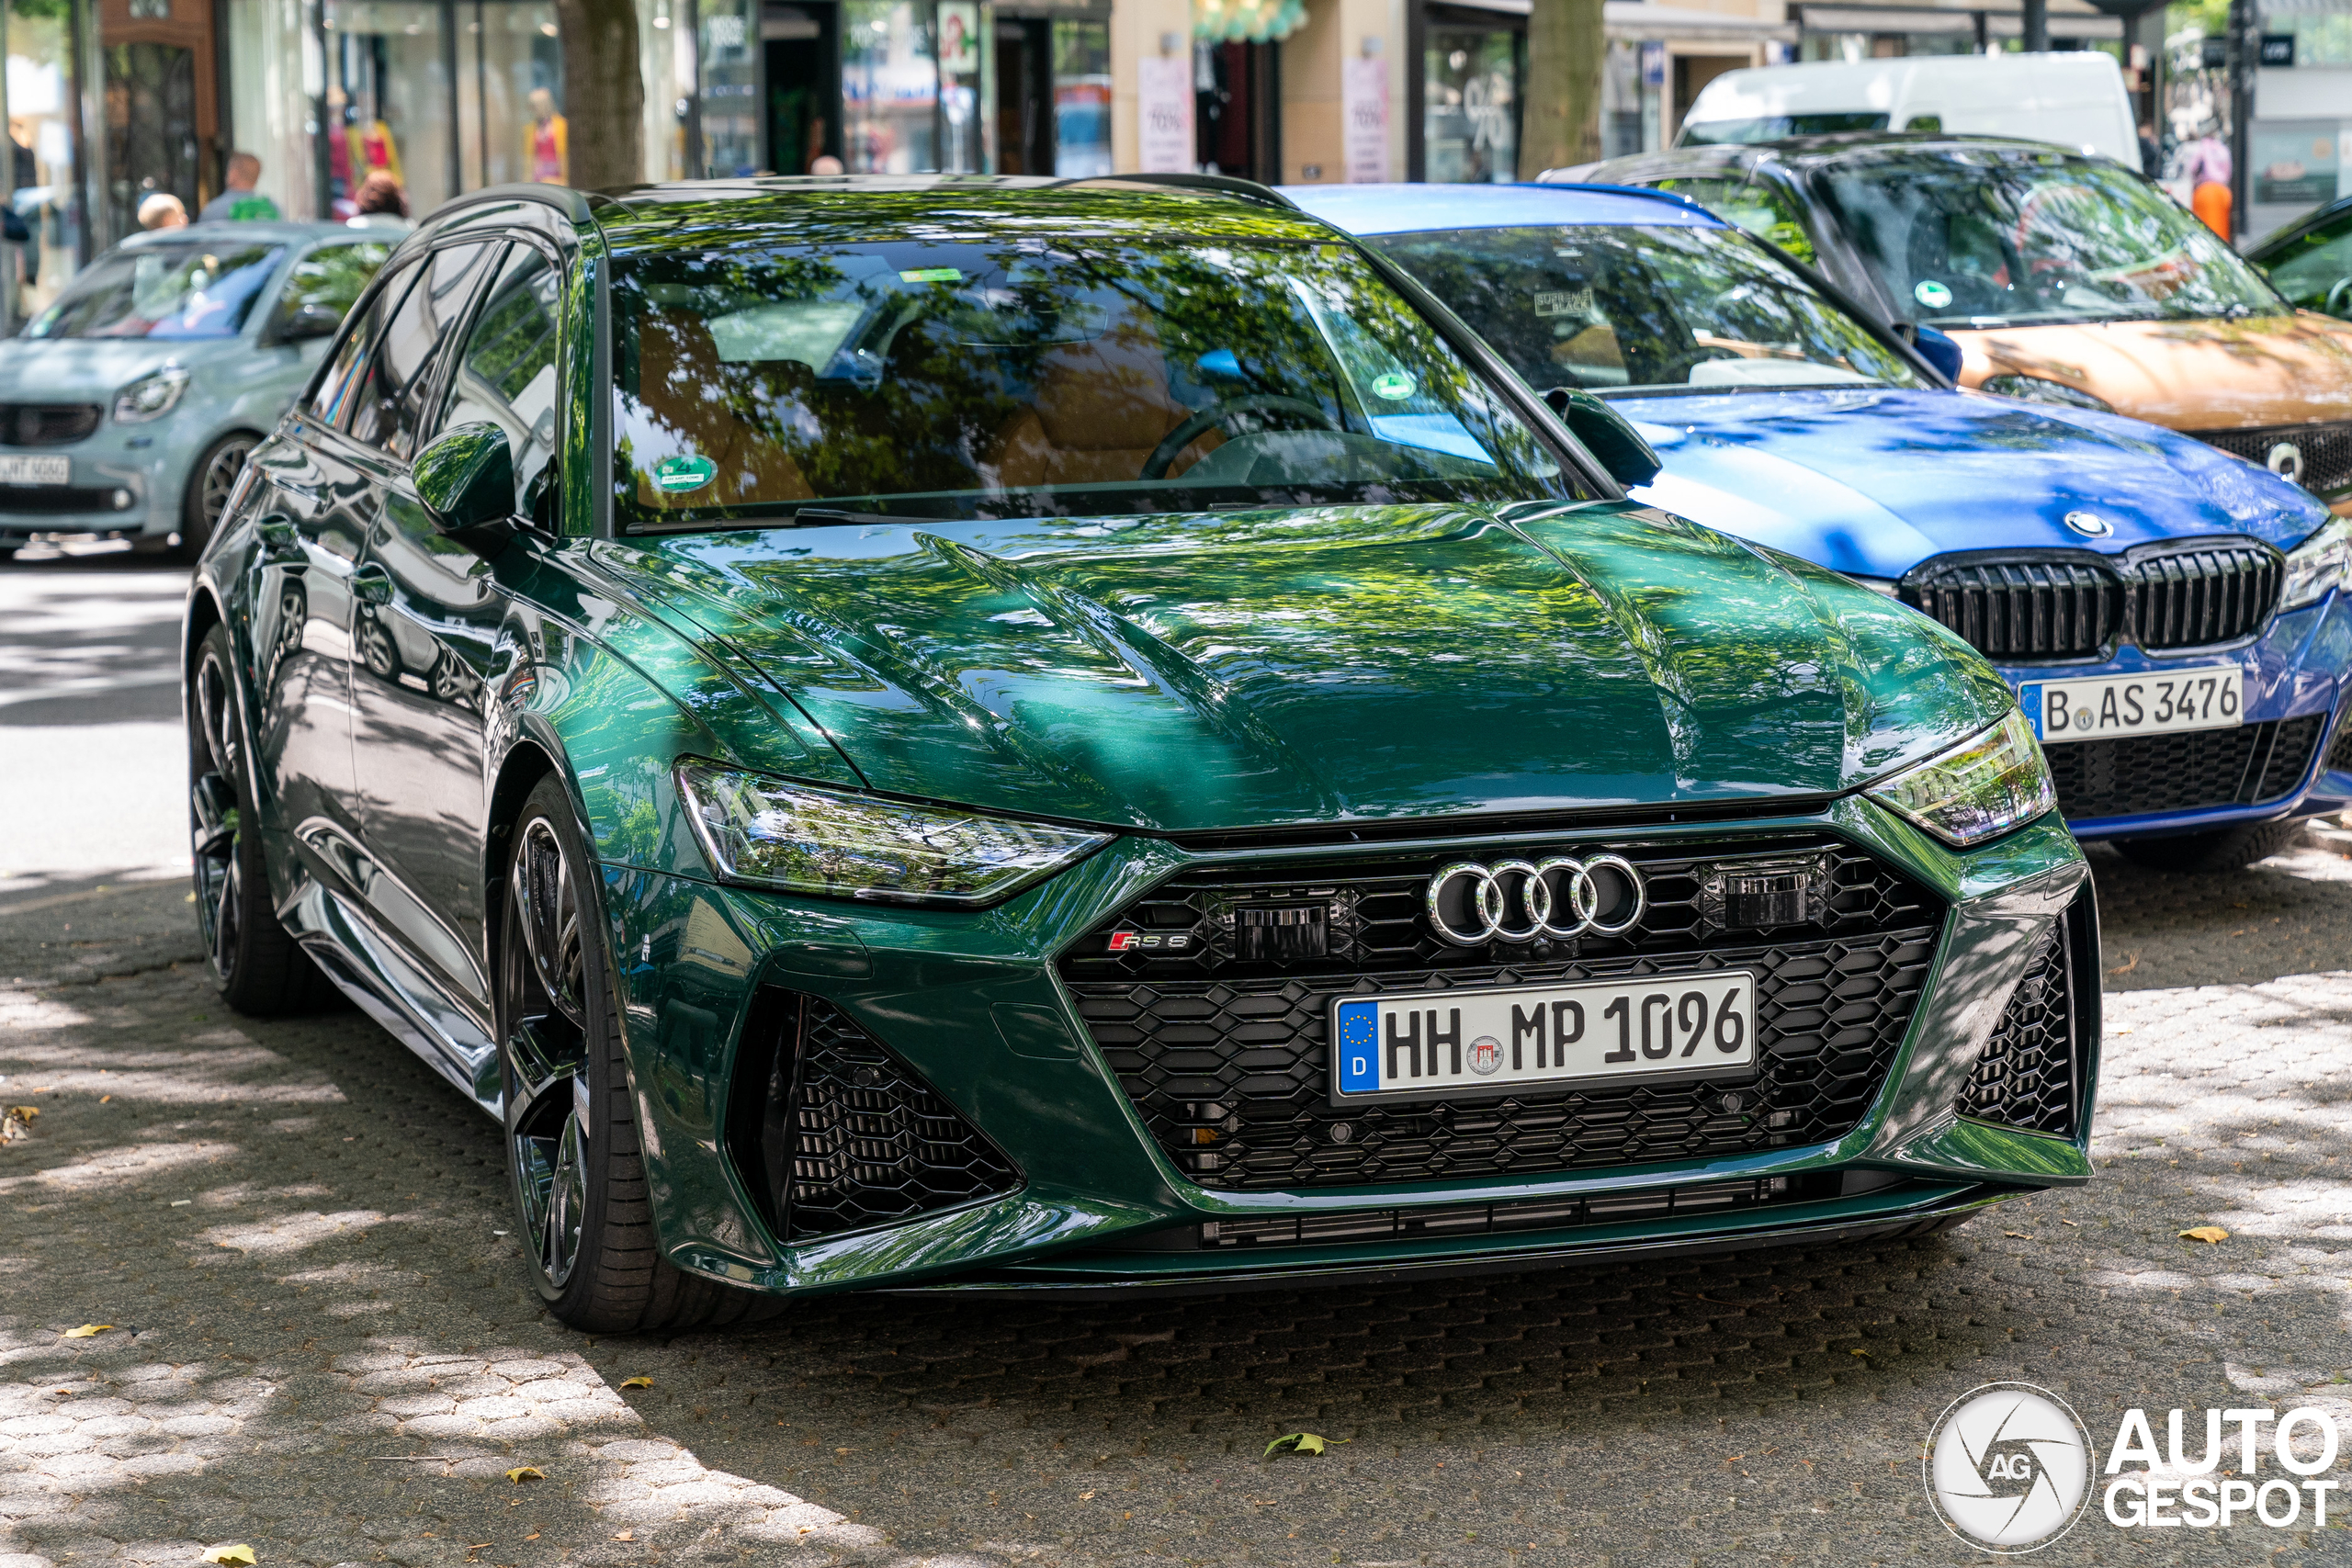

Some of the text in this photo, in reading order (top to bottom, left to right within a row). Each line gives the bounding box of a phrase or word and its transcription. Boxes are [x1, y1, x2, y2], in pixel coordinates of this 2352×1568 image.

[1537, 289, 1589, 305] SUPREME
[1553, 299, 1588, 312] BLACK
[676, 458, 692, 473] 4
[2048, 676, 2238, 731] B AS 3476
[1121, 935, 1188, 948] RS 6
[1385, 1007, 1462, 1079] HH
[1511, 999, 1586, 1070] MP
[1603, 987, 1745, 1065] 1096
[1352, 1056, 1366, 1076] D
